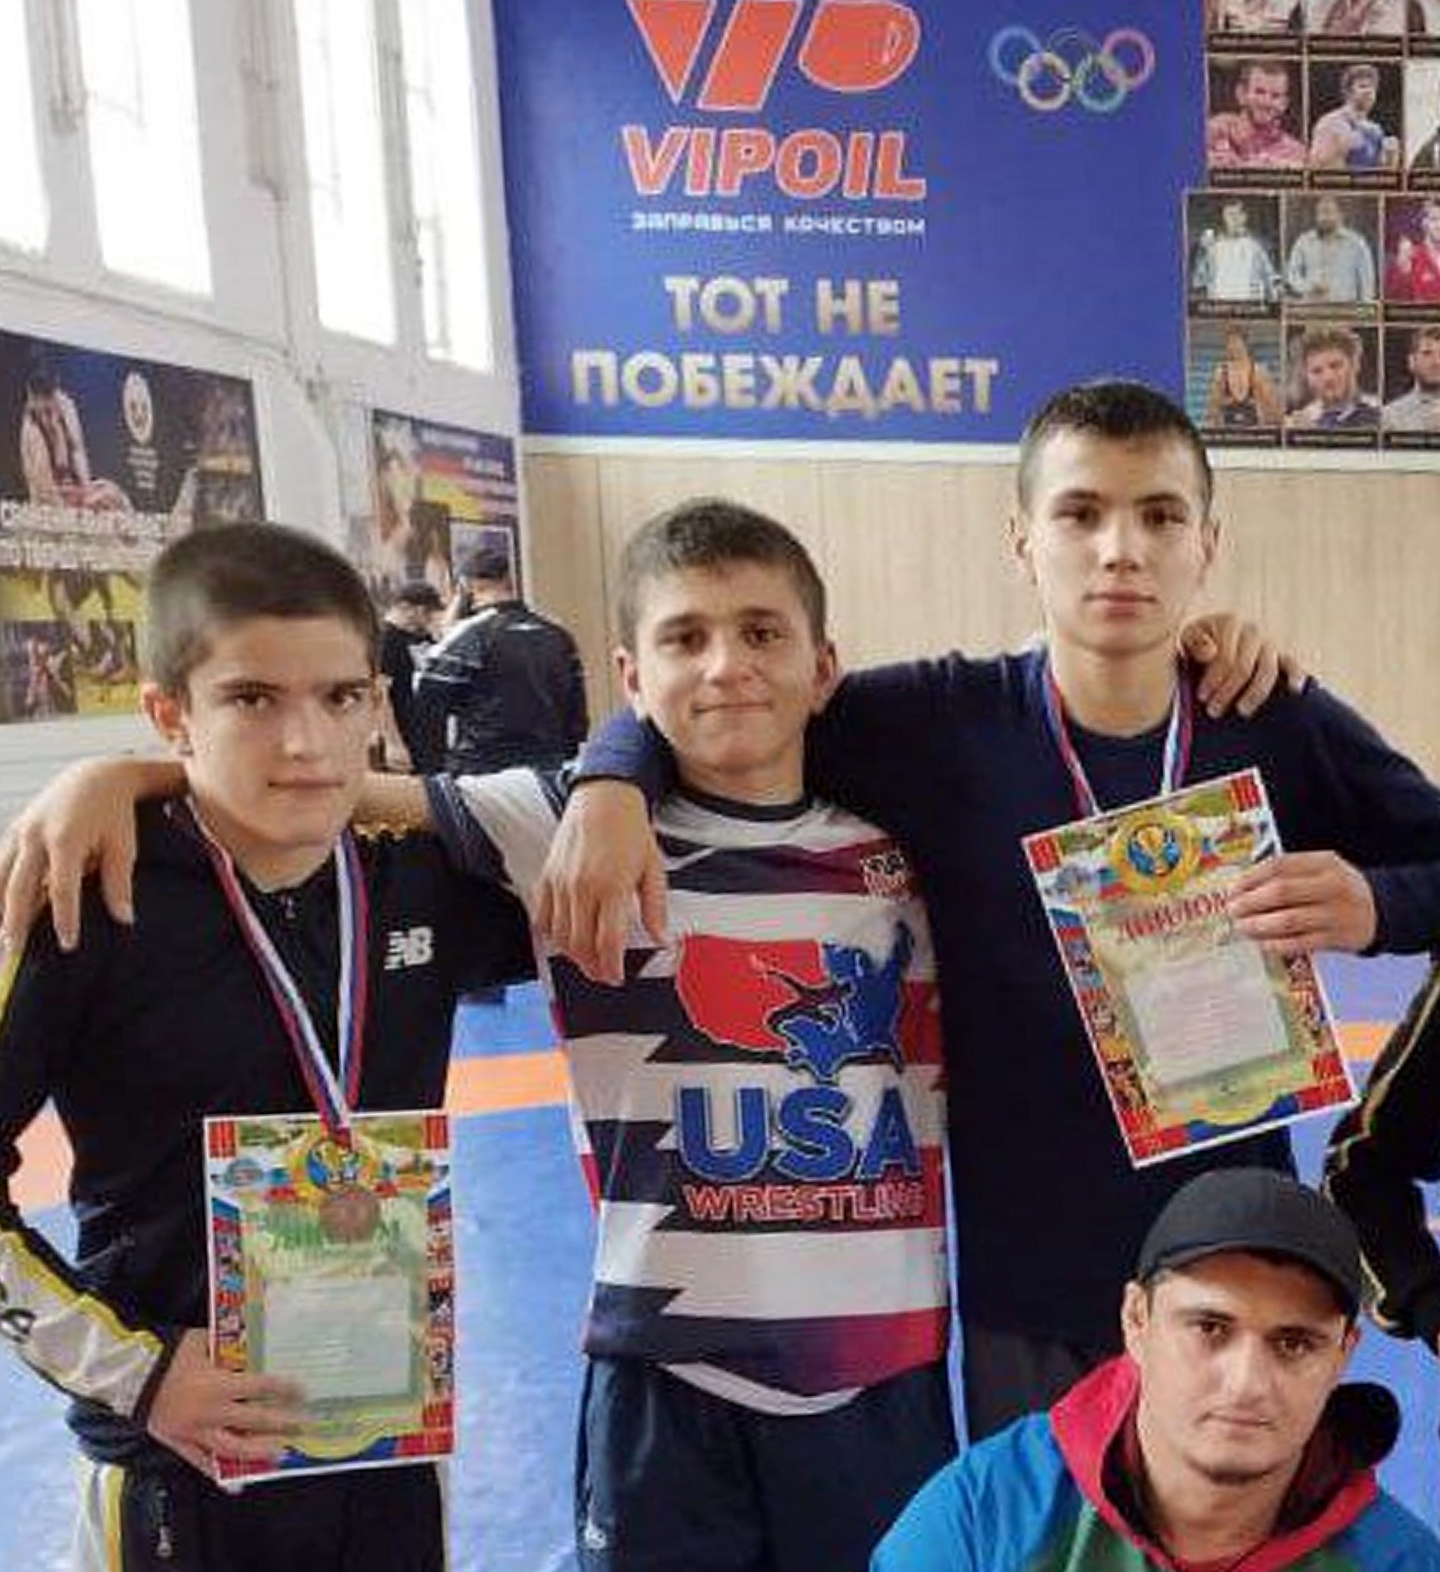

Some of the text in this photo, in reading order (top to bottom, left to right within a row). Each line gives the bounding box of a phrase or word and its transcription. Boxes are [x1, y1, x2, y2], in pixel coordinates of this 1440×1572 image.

[620, 125, 928, 201] VIPOIL
[664, 275, 901, 337] ТОТ НЕ
[571, 350, 999, 420] ПОБЕЖДАЕТ
[677, 1084, 925, 1182] USA
